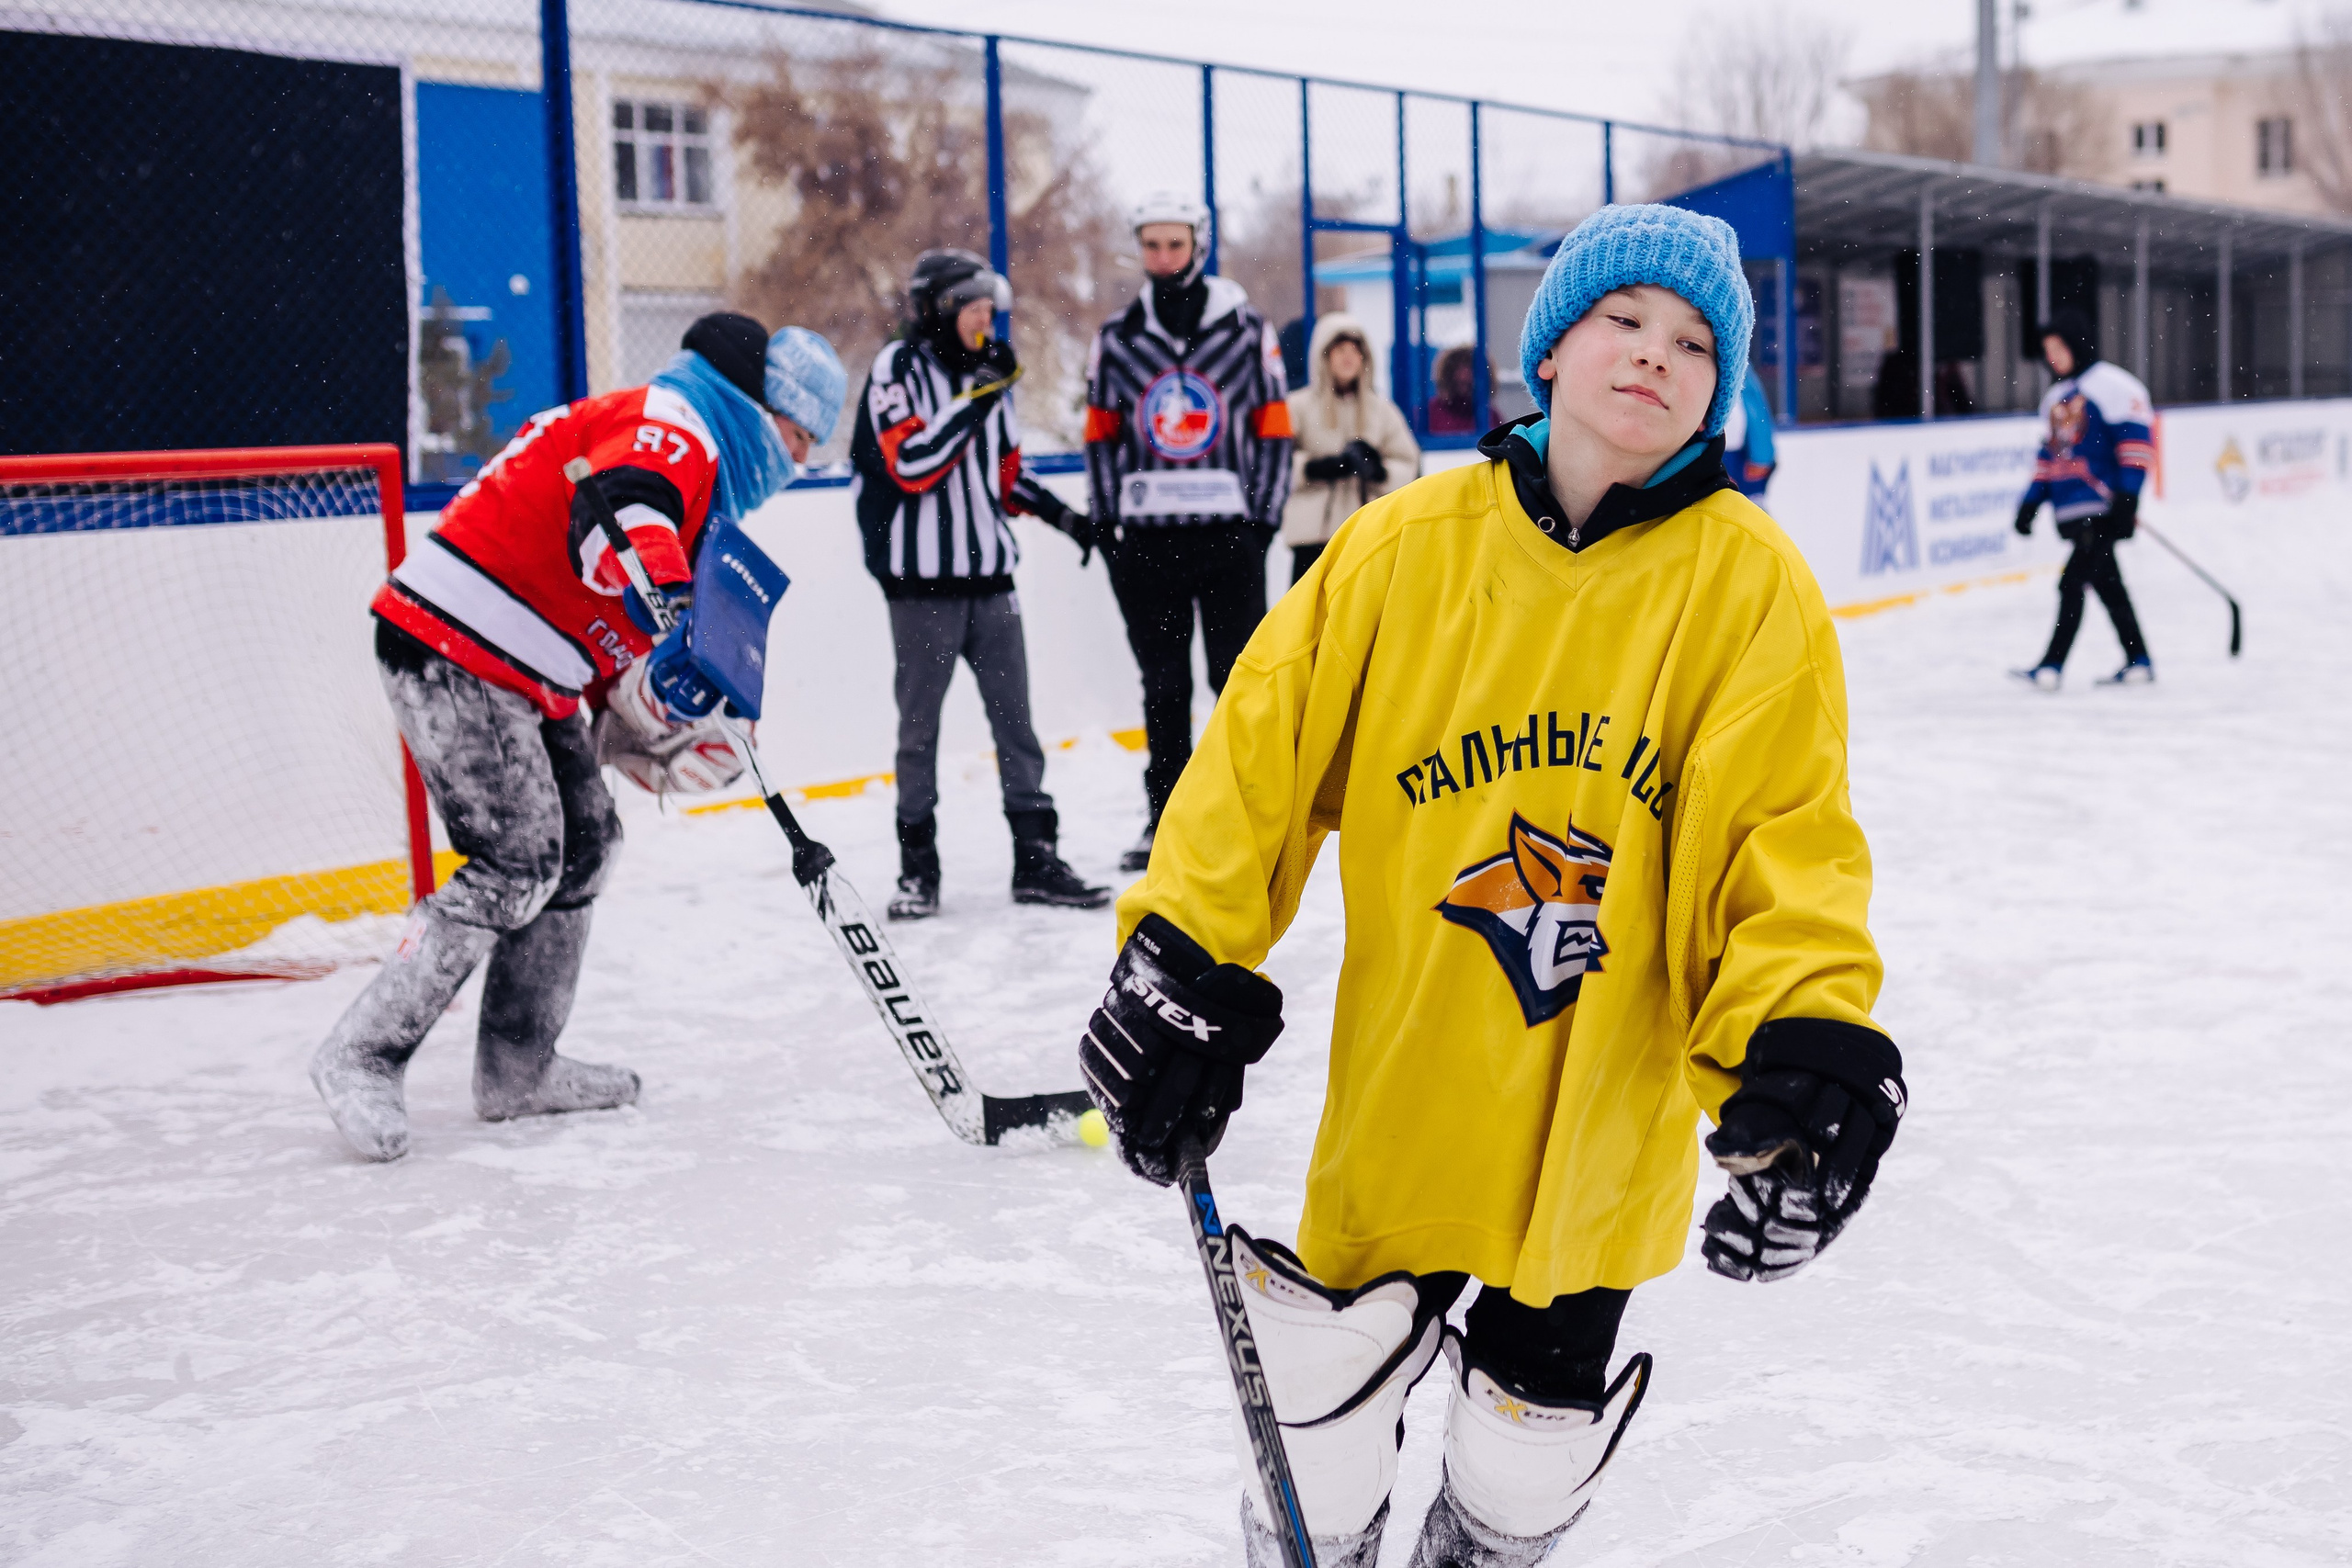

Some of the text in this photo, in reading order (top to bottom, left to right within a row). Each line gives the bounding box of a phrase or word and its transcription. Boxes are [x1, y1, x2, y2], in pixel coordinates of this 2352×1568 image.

[633, 424, 689, 465] 97
[840, 922, 962, 1099] BAUER
[1206, 1236, 1272, 1407] NEXUS
